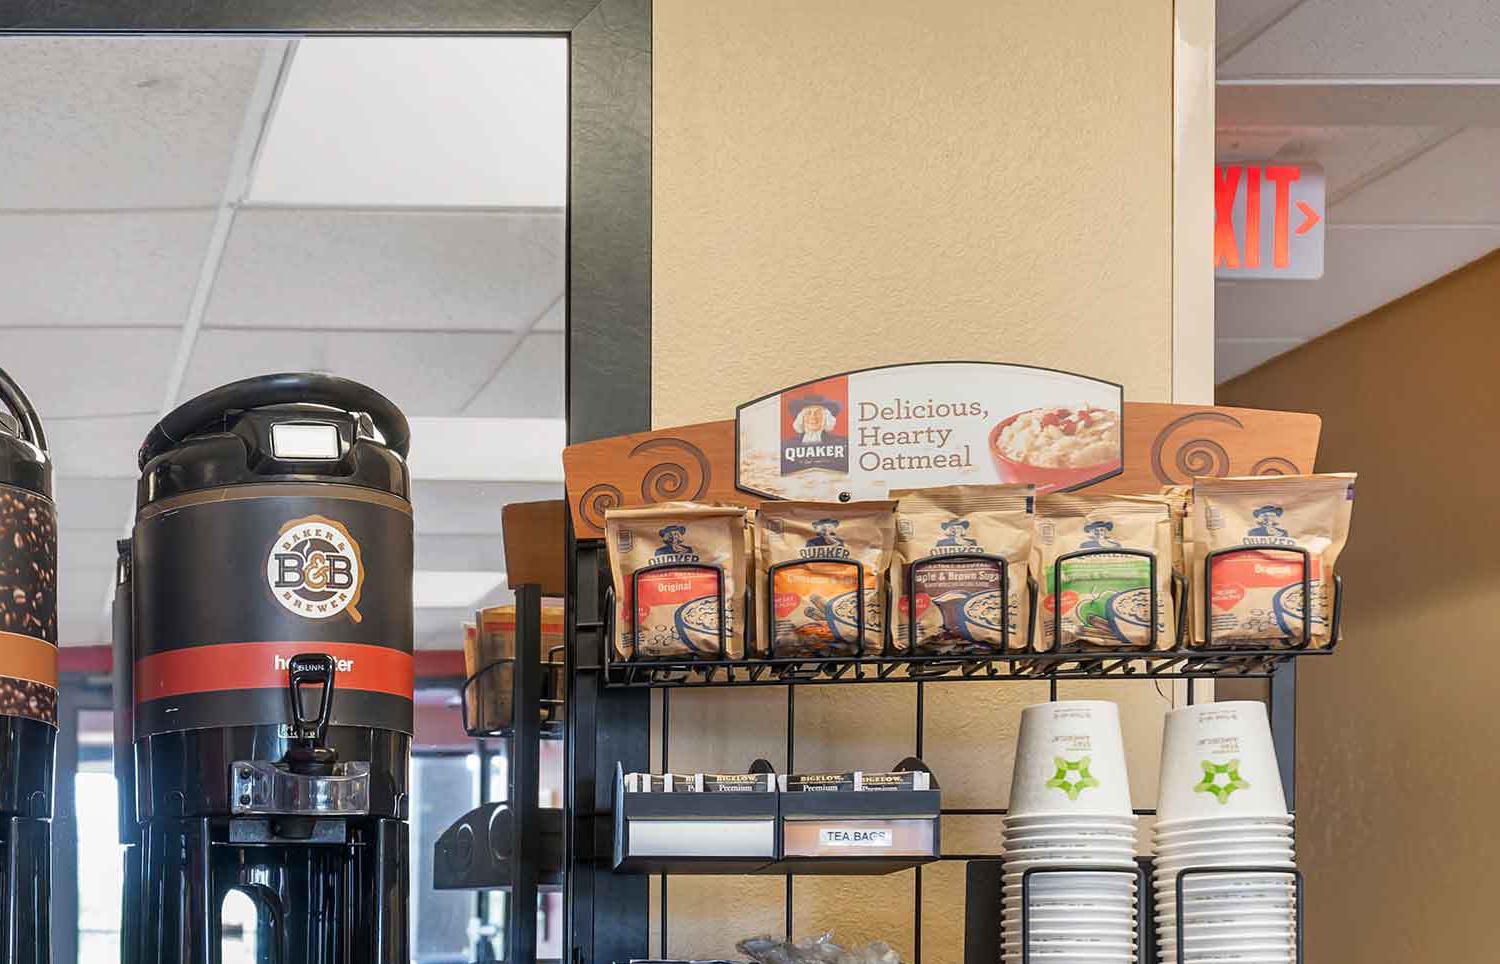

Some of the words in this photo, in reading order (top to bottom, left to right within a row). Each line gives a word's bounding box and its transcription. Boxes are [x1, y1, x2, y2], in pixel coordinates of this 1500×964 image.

[1215, 166, 1301, 269] XIT
[858, 398, 990, 422] Delicious,
[858, 425, 953, 448] Hearty
[785, 445, 846, 462] QUAKER
[858, 446, 973, 472] Oatmeal
[282, 528, 334, 550] BAKER
[800, 547, 850, 559] QUAKER
[274, 552, 353, 589] B&B
[979, 571, 999, 583] Suga
[658, 581, 692, 593] Original
[283, 591, 348, 613] BREWER
[719, 784, 752, 792] Premium
[803, 784, 838, 792] Premium
[827, 831, 850, 841] TEA
[853, 831, 885, 841] BAGS
